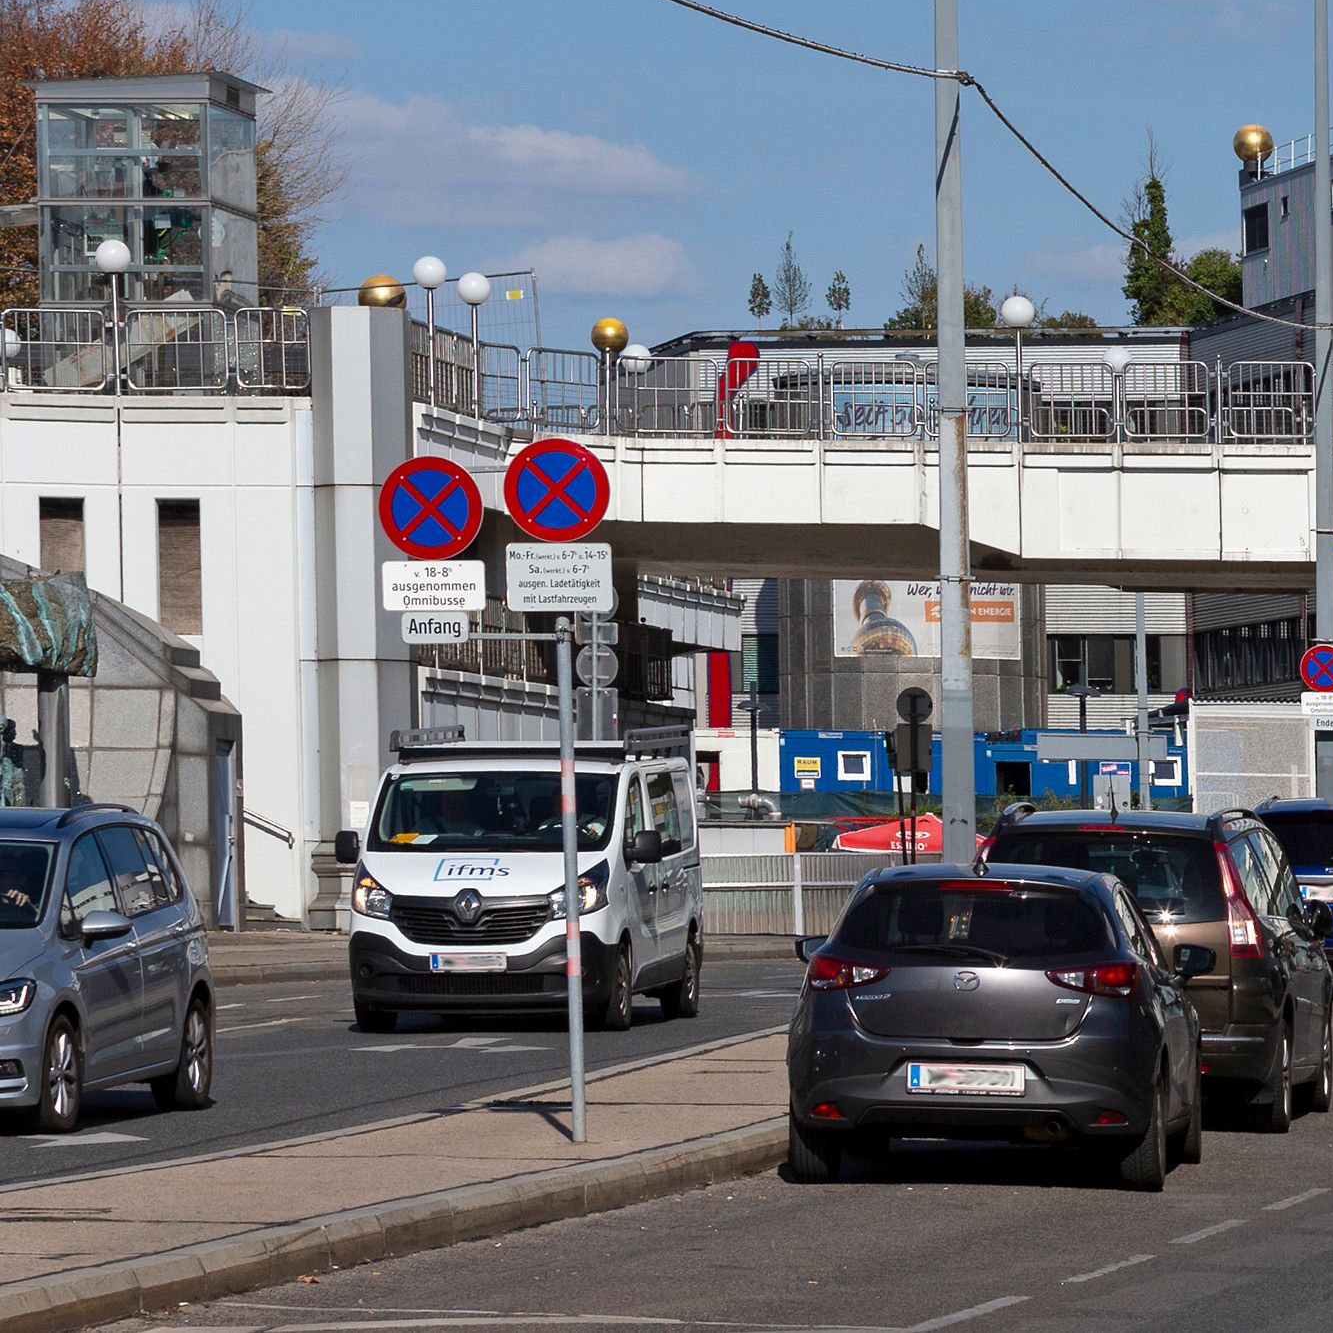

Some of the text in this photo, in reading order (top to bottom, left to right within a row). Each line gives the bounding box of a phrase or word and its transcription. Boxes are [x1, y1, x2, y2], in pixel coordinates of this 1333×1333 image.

[391, 582, 476, 595] ausgenommen
[518, 578, 601, 590] ausgen. Ladetätigkeit
[907, 583, 932, 598] Wer,
[970, 583, 997, 596] nicht
[403, 595, 466, 607] Omnibusse
[523, 593, 597, 606] mit Lastfahrzeugen
[978, 607, 1012, 616] ENERGIE
[408, 617, 462, 638] Anfang
[890, 841, 925, 851] ESIO
[447, 862, 510, 877] ifms
